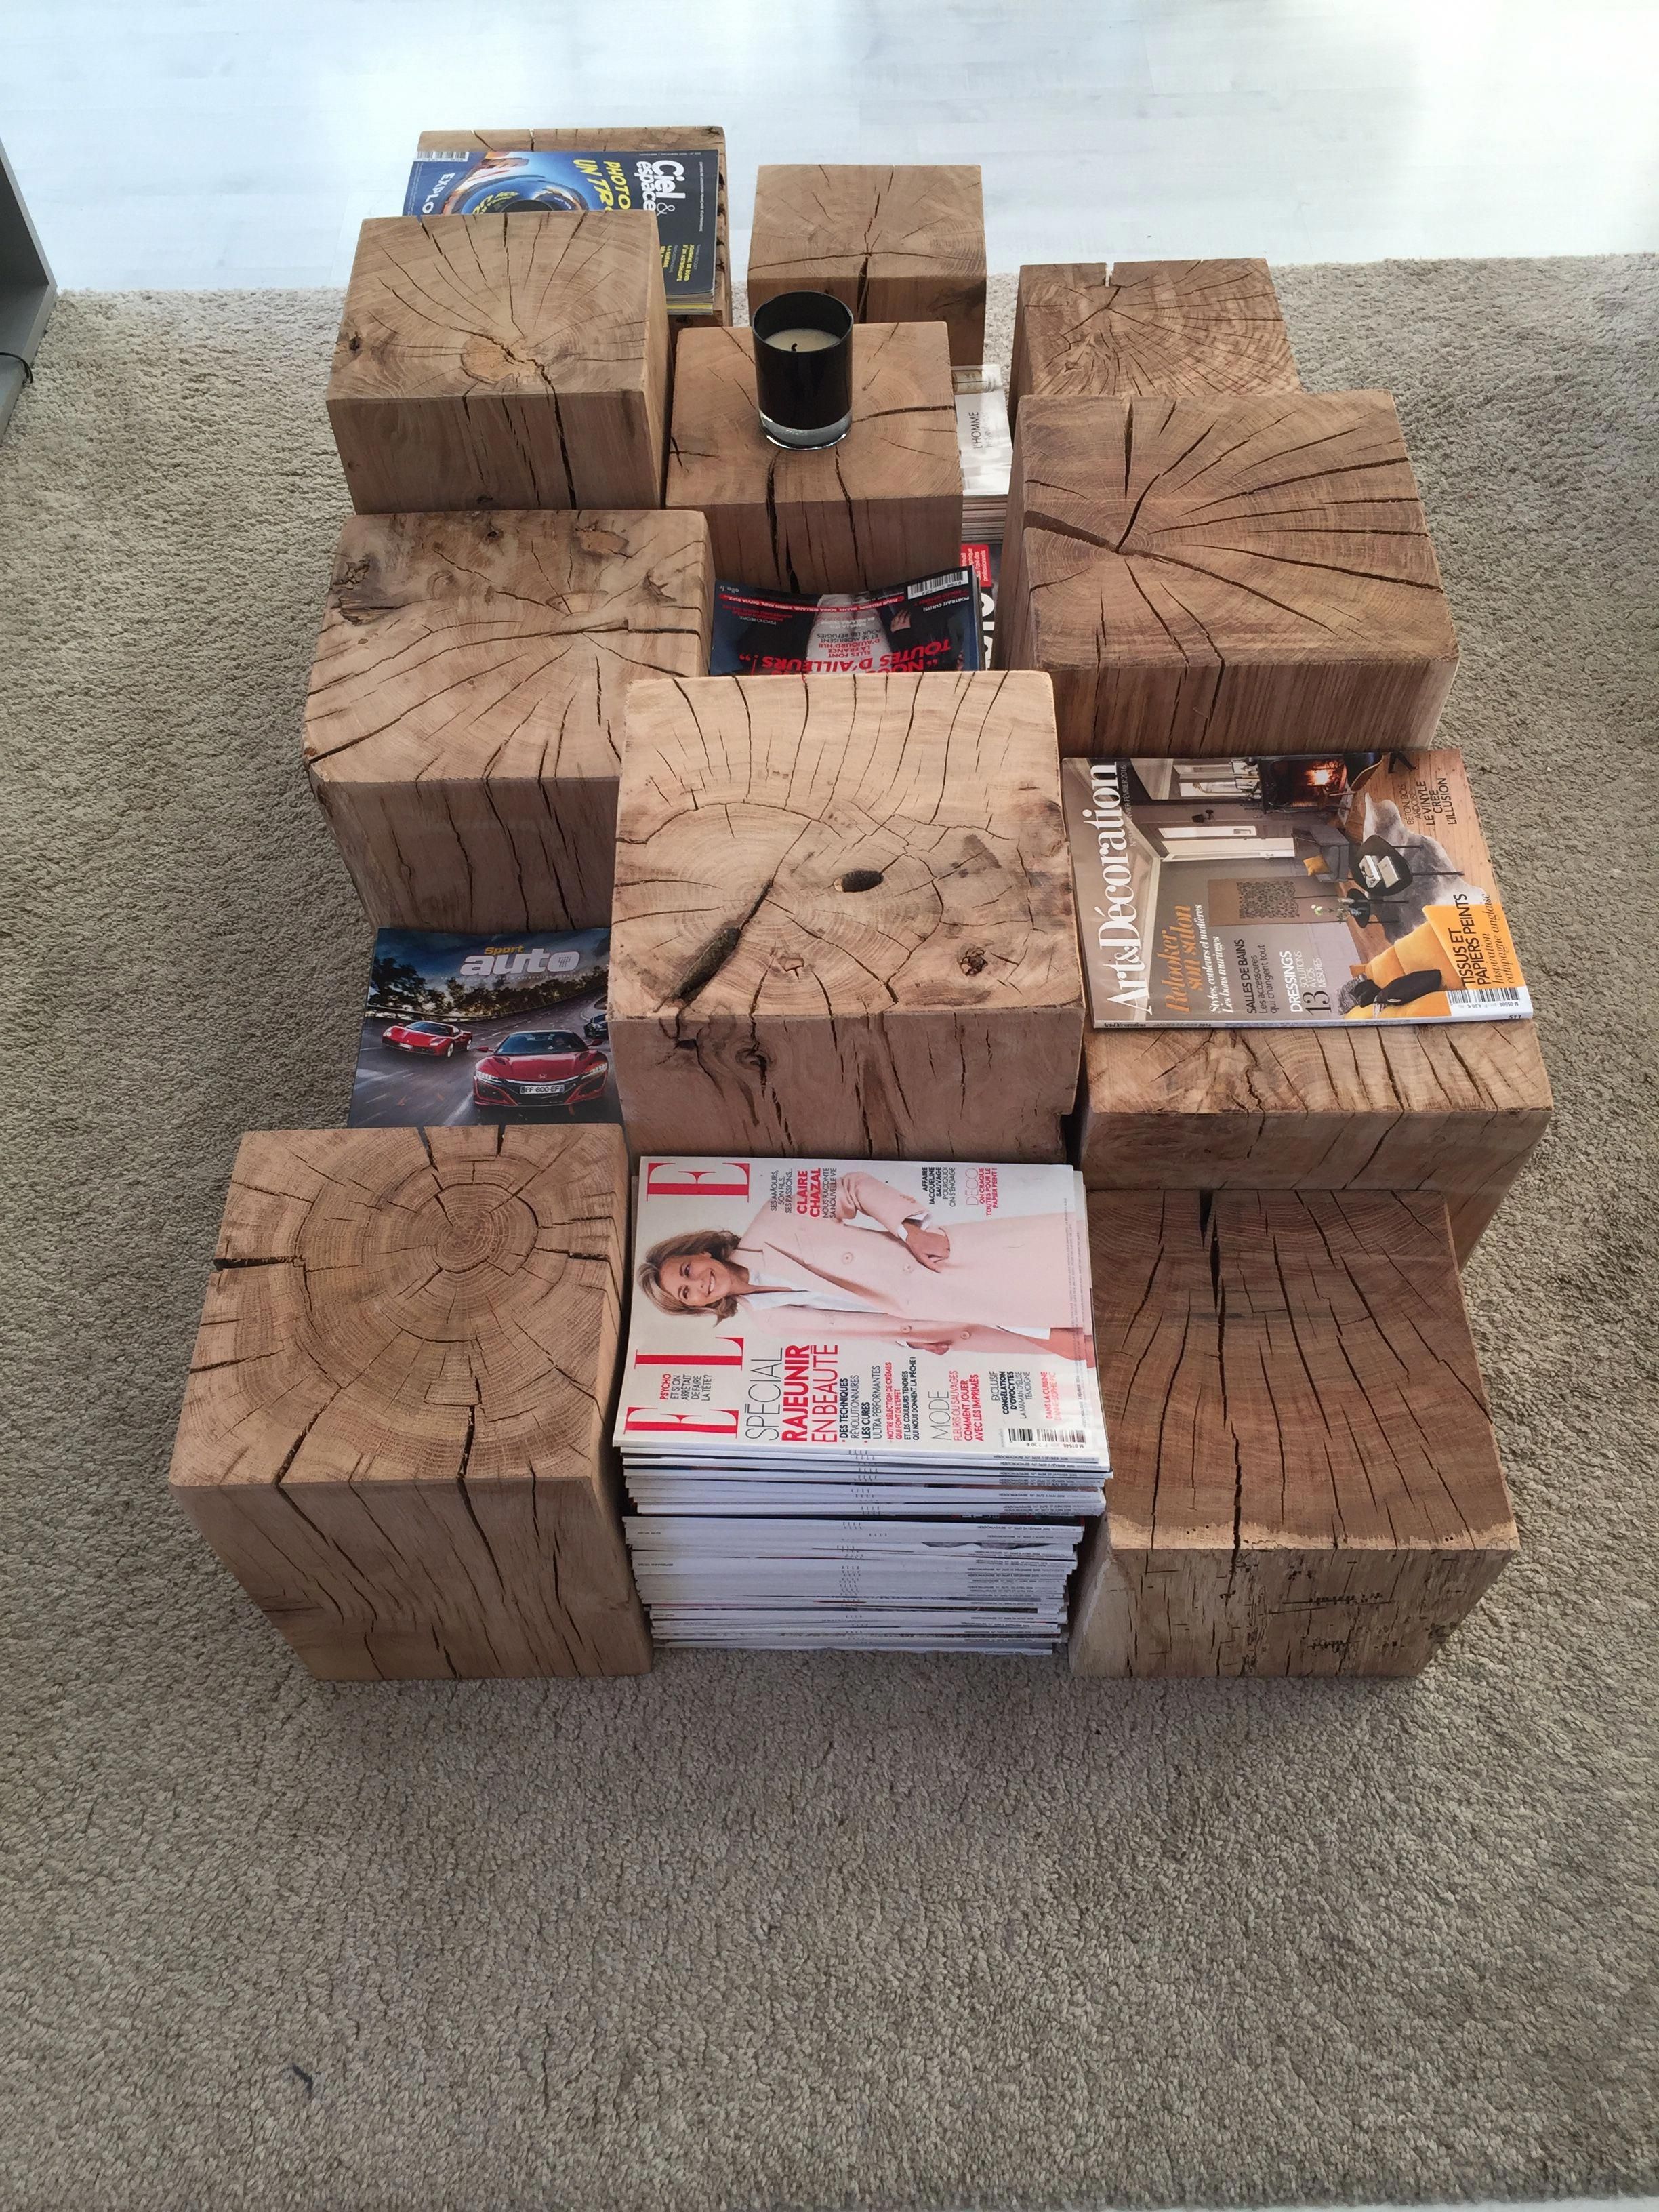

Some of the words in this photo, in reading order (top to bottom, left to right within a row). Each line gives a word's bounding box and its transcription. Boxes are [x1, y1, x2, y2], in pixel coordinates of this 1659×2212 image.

[422, 173, 456, 213] EXPLO
[573, 159, 602, 176] UN
[588, 178, 614, 211] TR
[634, 161, 656, 210] espace
[651, 160, 686, 199] Ciel
[656, 203, 675, 216] &
[968, 412, 982, 449] L'HOMME
[719, 585, 739, 593] elle.fr
[818, 638, 880, 648] D'AUJOURD'HUI
[879, 638, 951, 664] TOUTES
[761, 655, 873, 673] D'AILLEURS
[1416, 781, 1431, 814] VINYLE
[1437, 778, 1457, 825] L'ILLUSION
[1424, 815, 1435, 825] LE
[1193, 905, 1208, 939] matières
[1453, 894, 1476, 934] PEINTS
[1480, 893, 1500, 933] anglaise
[1169, 905, 1197, 956] salon
[1448, 928, 1465, 943] ET
[459, 948, 580, 976] auto
[484, 945, 525, 955] Sport
[1212, 935, 1226, 975] mariages
[1233, 939, 1248, 965] BAINS
[1257, 945, 1268, 961] tout
[1465, 937, 1492, 985] PAPIERS
[1481, 933, 1504, 983] Inspiration
[1494, 935, 1515, 983] campagne
[1156, 929, 1190, 1012] Relooker
[1185, 959, 1203, 989] son
[1202, 950, 1215, 984] couleurs
[1240, 967, 1250, 980] DE
[1251, 955, 1265, 998] accessoires
[1263, 962, 1275, 998] changent
[1279, 951, 1303, 1012] DRESSINGS
[1294, 951, 1308, 987] SOLUTIONS
[1307, 968, 1315, 982] VOS
[1313, 958, 1326, 987] MESURES
[1453, 947, 1475, 987] TISSUS
[1206, 986, 1221, 1013] Styles,
[1218, 977, 1229, 996] bons
[1242, 982, 1257, 1014] SALLES
[1221, 998, 1233, 1012] Les
[1258, 1000, 1268, 1014] Les
[1268, 1000, 1279, 1014] qui
[1302, 991, 1332, 1015] 13
[770, 1170, 779, 1200] AMOURS,
[797, 1170, 808, 1214] CLAIRE
[810, 1168, 821, 1217] CHAZAL
[979, 1194, 985, 1204] ON
[949, 1197, 956, 1207] ON
[623, 1162, 750, 1439] ELE
[659, 1374, 671, 1399] PSYCHO
[672, 1376, 681, 1385] ON
[680, 1374, 691, 1400] ARRÊTAIT
[691, 1376, 701, 1391] FAIRE
[782, 1345, 810, 1441] RAJEUNIR
[810, 1344, 838, 1412] BEAUTÉ
[872, 1366, 882, 1416] PERFORMANTES
[949, 1370, 960, 1404] SAUVAGES
[960, 1380, 970, 1402] JOUER
[969, 1374, 981, 1408] IMPRIMÉS
[989, 1371, 1000, 1401] EXCLUSIF
[999, 1371, 1009, 1414] CONGÉLATION
[1007, 1372, 1017, 1410] D'OVOCYTES
[1023, 1372, 1032, 1399] TÉMOIGNE
[1040, 1372, 1050, 1395] CUISINE
[743, 1348, 783, 1441] SPÉCIAL
[840, 1378, 848, 1422] TECHNIQUES
[850, 1375, 860, 1439] RÉVOLUTIONNAIRES
[1017, 1390, 1025, 1412] MAMAN
[861, 1402, 871, 1425] CURES
[928, 1391, 951, 1441] MODE
[951, 1405, 960, 1416] OU
[962, 1404, 973, 1441] COMMENT
[972, 1410, 982, 1421] LES
[1044, 1404, 1052, 1419] DANS
[812, 1418, 838, 1442] EN
[840, 1425, 848, 1438] DES
[862, 1427, 870, 1439] LES
[873, 1418, 882, 1439] ULTRA
[952, 1417, 962, 1441] FLEURIS
[974, 1422, 984, 1441] AVEC
